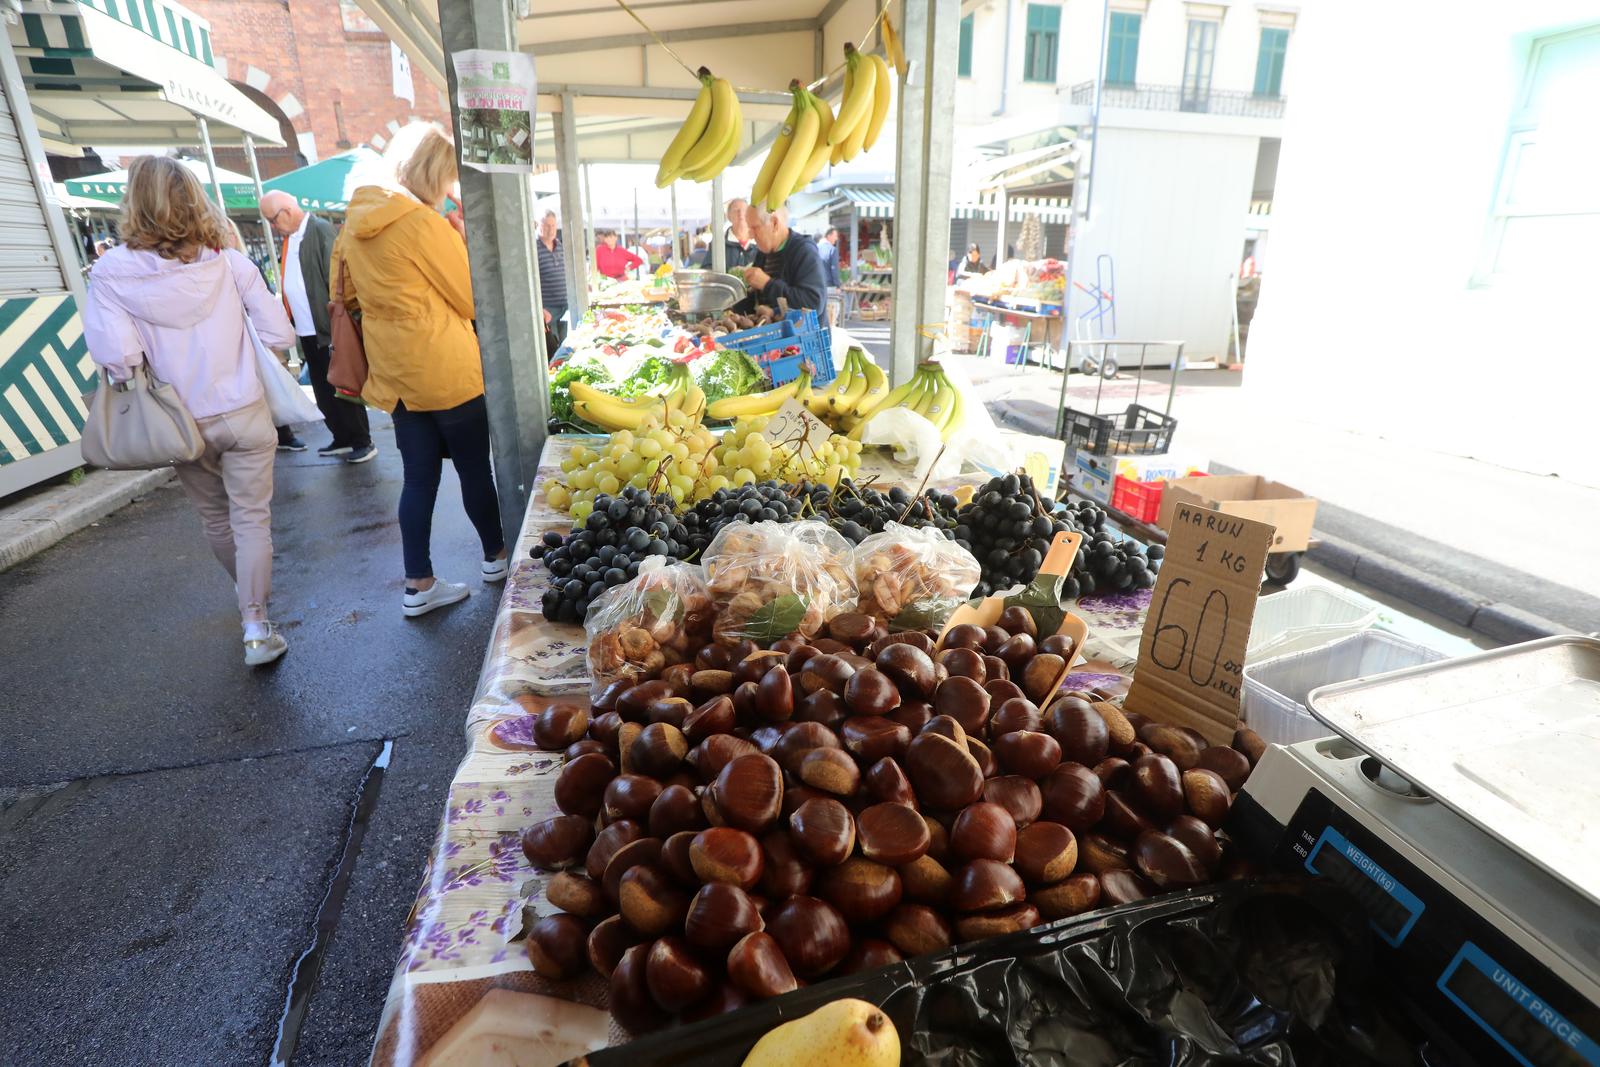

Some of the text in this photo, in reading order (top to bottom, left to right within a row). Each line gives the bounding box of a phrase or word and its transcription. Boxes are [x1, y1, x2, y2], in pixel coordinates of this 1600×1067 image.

[168, 79, 212, 109] PLACA
[82, 183, 128, 194] PLAC
[1179, 508, 1244, 537] MARUN
[1196, 541, 1246, 573] 1 KG
[1151, 577, 1229, 687] 60
[1292, 842, 1308, 858] ZERO
[1301, 830, 1316, 845] TARE
[1346, 845, 1396, 893] WEIGHT(kg)
[1491, 969, 1582, 1047] UNIT PRICE
